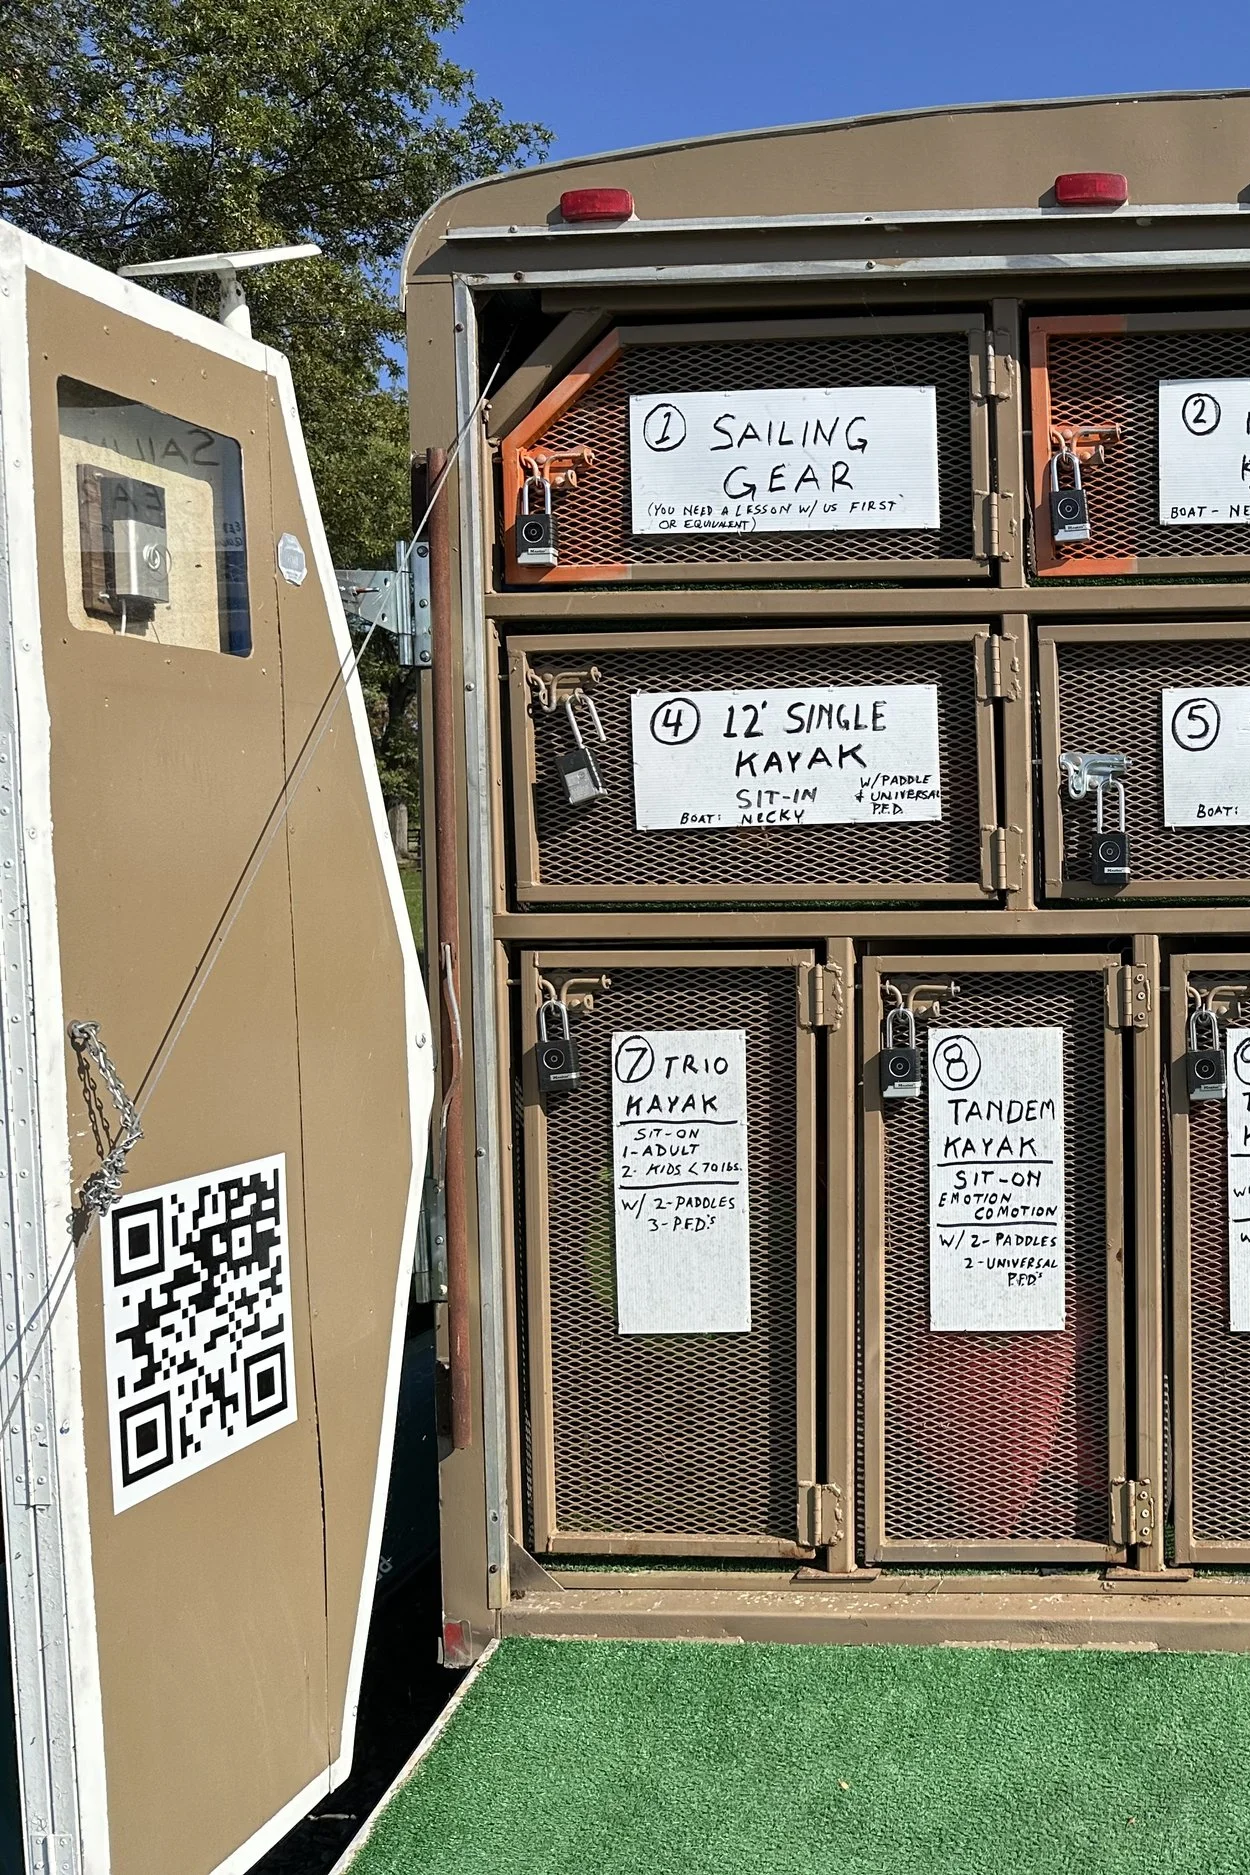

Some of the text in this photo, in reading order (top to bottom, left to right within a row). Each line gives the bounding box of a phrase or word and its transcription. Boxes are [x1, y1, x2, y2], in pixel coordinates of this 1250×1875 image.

[710, 414, 868, 454] SAILING
[723, 460, 853, 501] GEAR
[648, 503, 675, 517] (YOU
[683, 504, 712, 516] NEED
[721, 505, 728, 516] A
[735, 503, 791, 516] LESSON
[823, 503, 837, 513] US
[850, 500, 897, 513] FIRST
[1170, 505, 1207, 519] BOAT
[659, 517, 756, 532] OR EQUIVALENT)
[783, 700, 887, 734] SINGLE
[735, 743, 867, 778] KAYAK
[736, 786, 817, 809] SIT-IN
[664, 1054, 728, 1079] TRIO
[626, 1094, 718, 1116] KAYAK
[948, 1098, 1056, 1125] TANDEM
[634, 1128, 700, 1140] SIT-ON
[943, 1135, 1038, 1159] KAYAK
[646, 1163, 681, 1175] KIDS
[954, 1170, 1042, 1190] SIT-ON
[939, 1192, 1012, 1207] EMOTION
